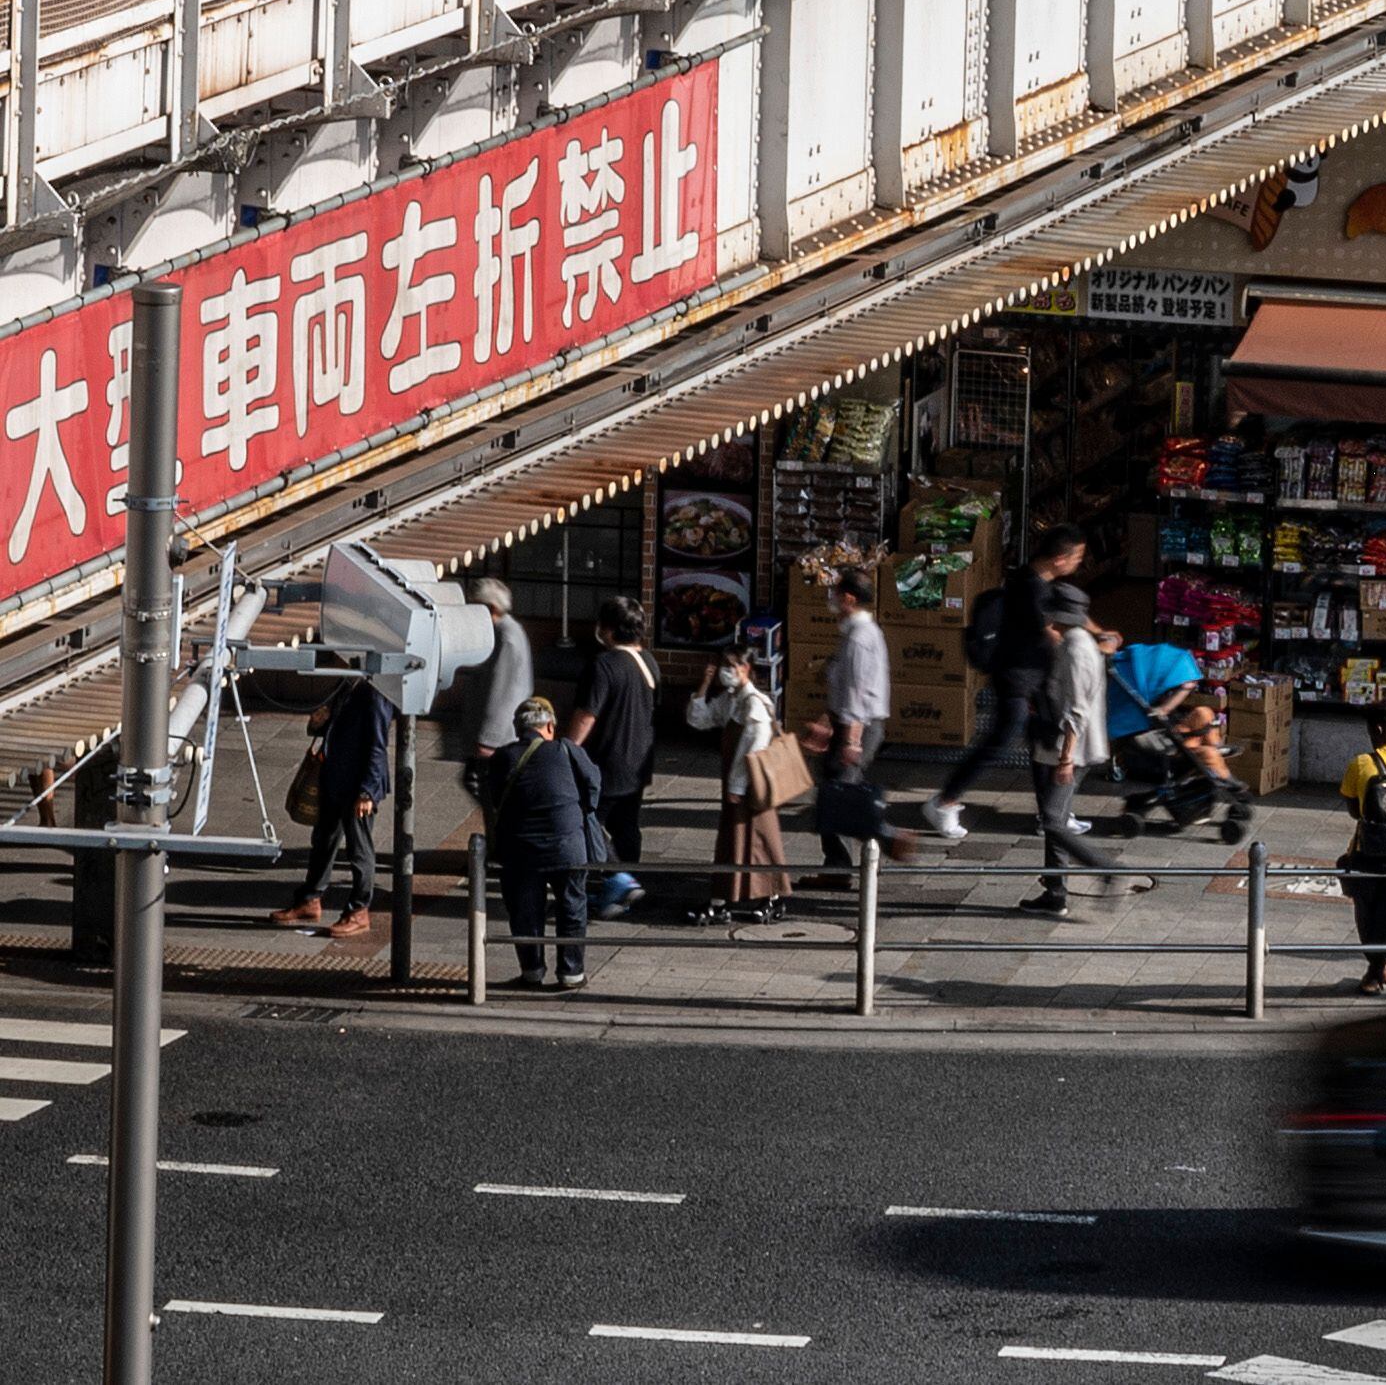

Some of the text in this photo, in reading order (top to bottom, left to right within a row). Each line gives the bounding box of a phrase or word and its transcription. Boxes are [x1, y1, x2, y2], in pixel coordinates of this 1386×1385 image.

[1090, 268, 1160, 292] オリジナル
[1090, 291, 1159, 315] 新製品続々
